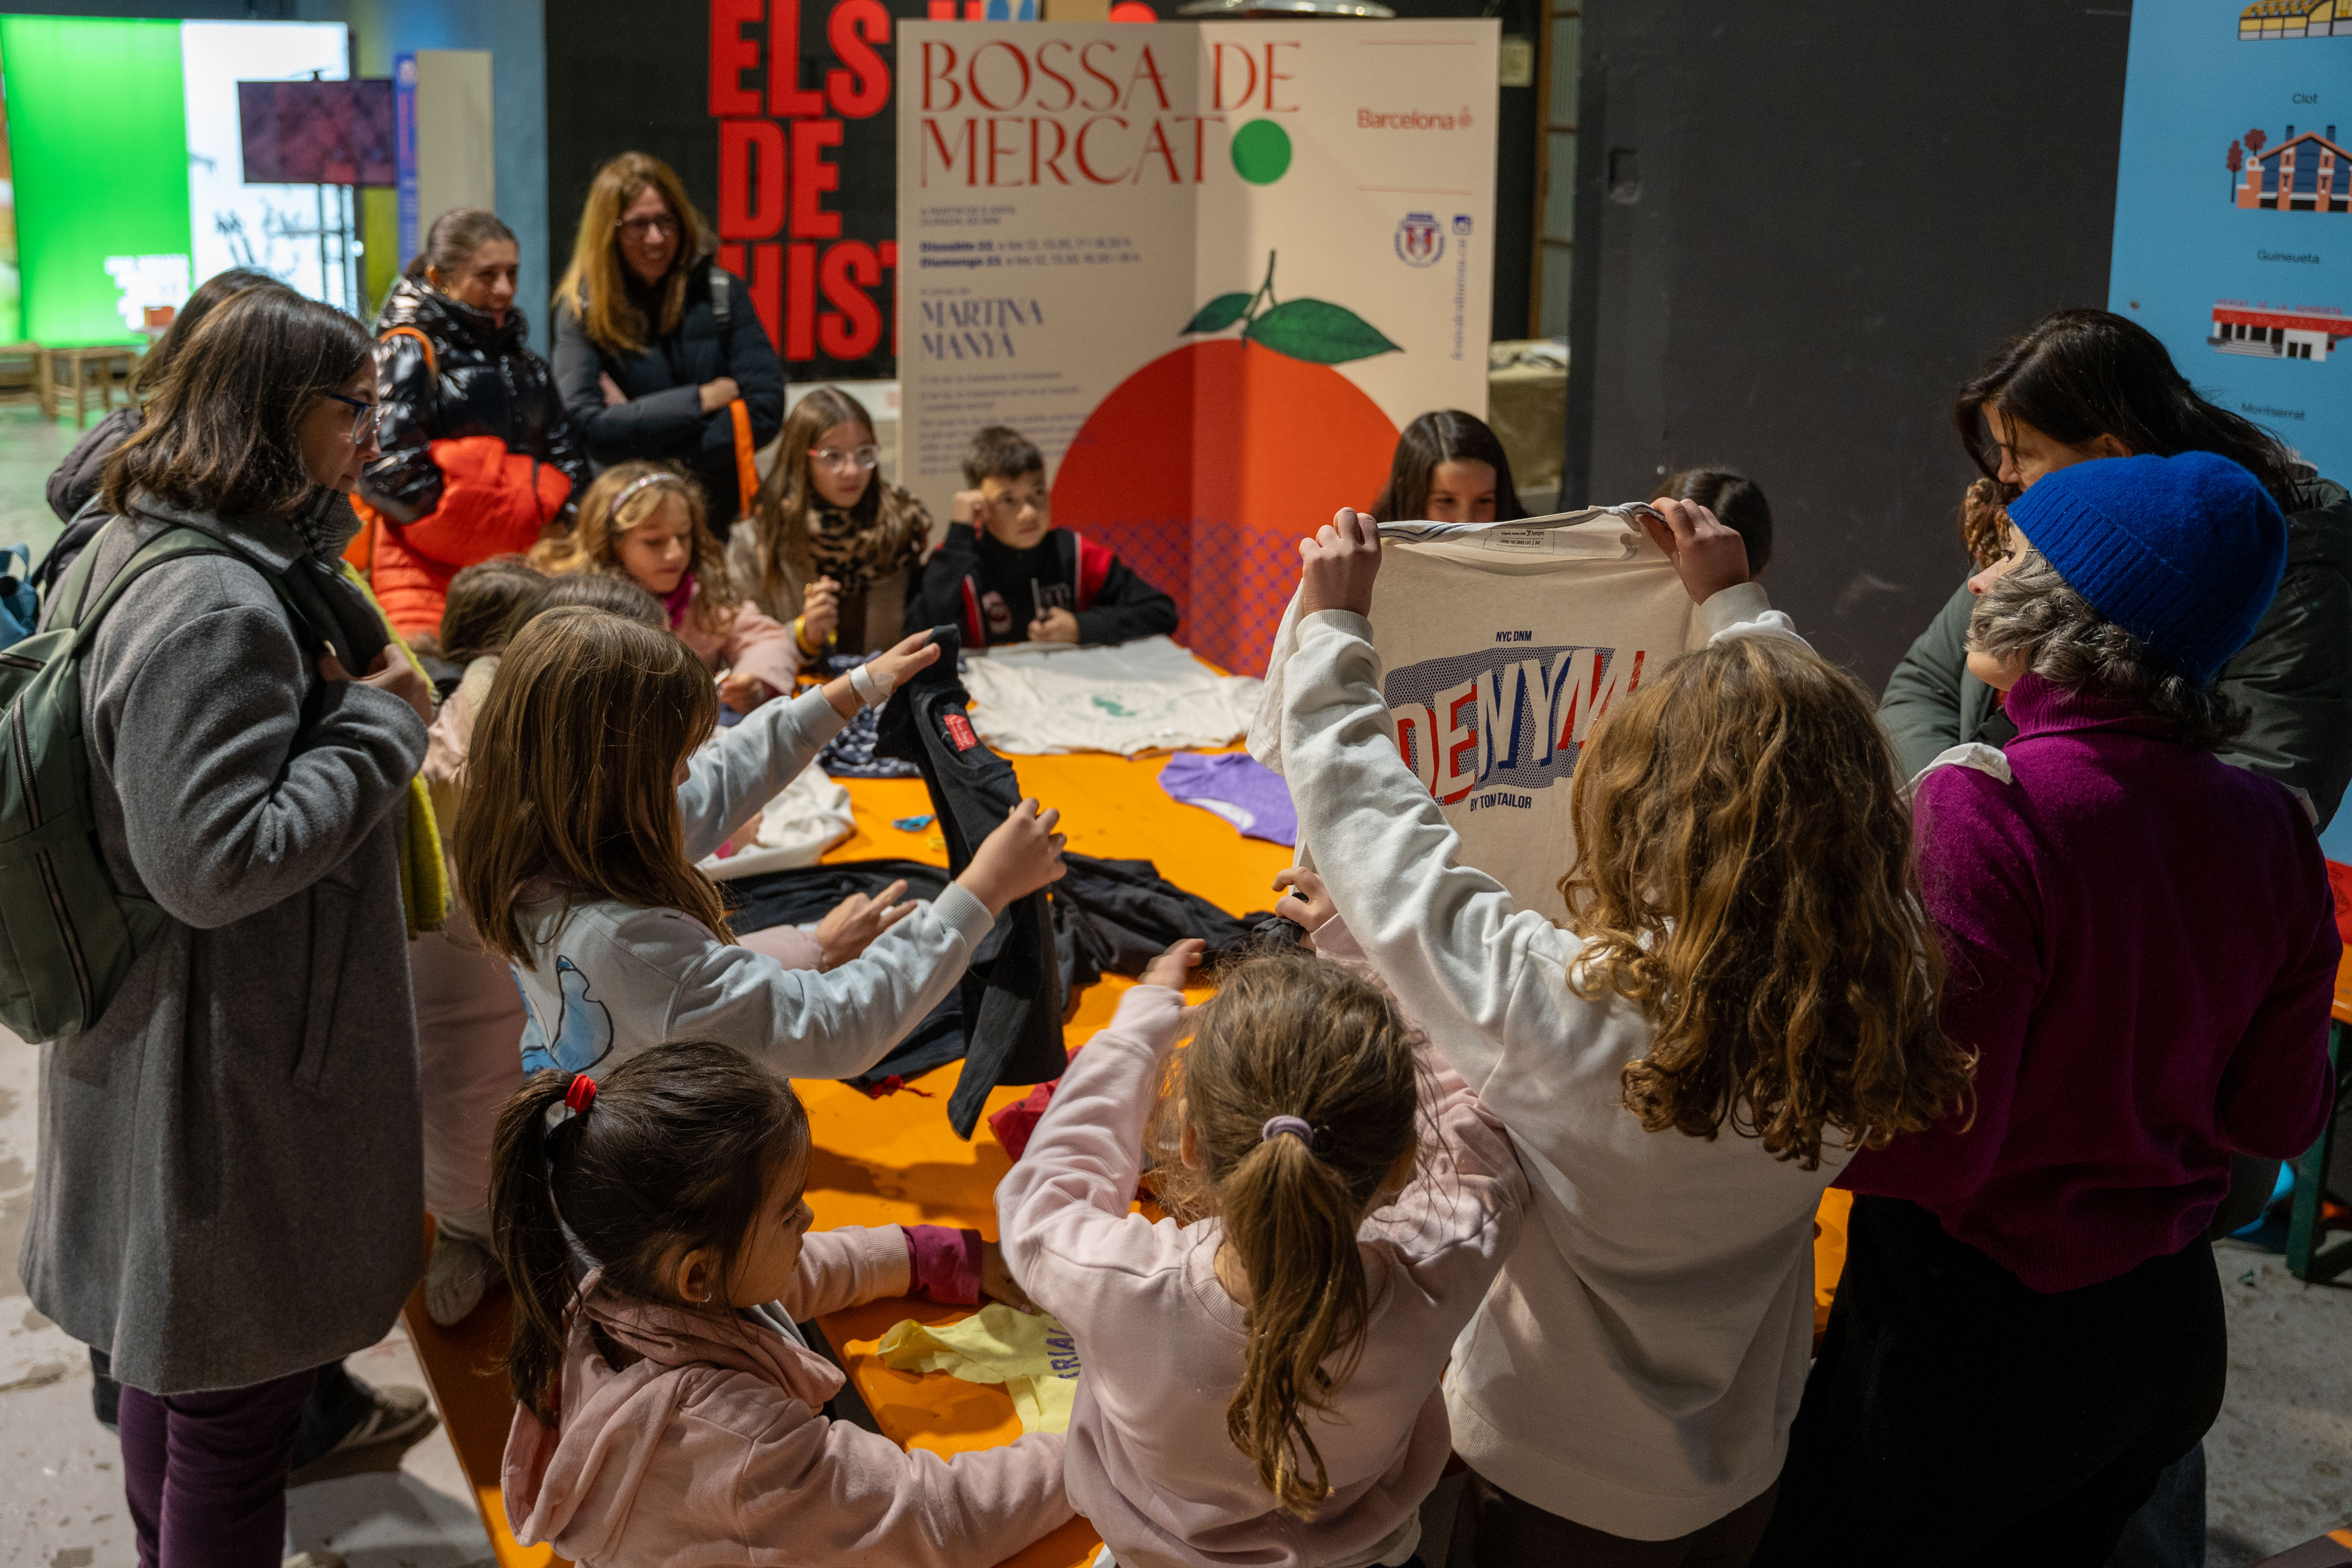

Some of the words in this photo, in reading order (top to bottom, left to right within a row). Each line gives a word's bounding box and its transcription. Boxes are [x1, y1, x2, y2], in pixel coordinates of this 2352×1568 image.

[708, 0, 892, 119] ELS
[920, 39, 1171, 113] BOSSA
[1212, 41, 1302, 113] DE
[2292, 93, 2318, 104] Clot
[1356, 107, 1454, 131] Barcelona
[920, 114, 1226, 188] MERCAT
[718, 119, 844, 240] DE
[921, 298, 1044, 328] MARTINA
[1495, 631, 1512, 642] NYC
[1513, 630, 1532, 642] DNM
[1470, 797, 1479, 812] BY
[1497, 792, 1532, 809] TAILOR
